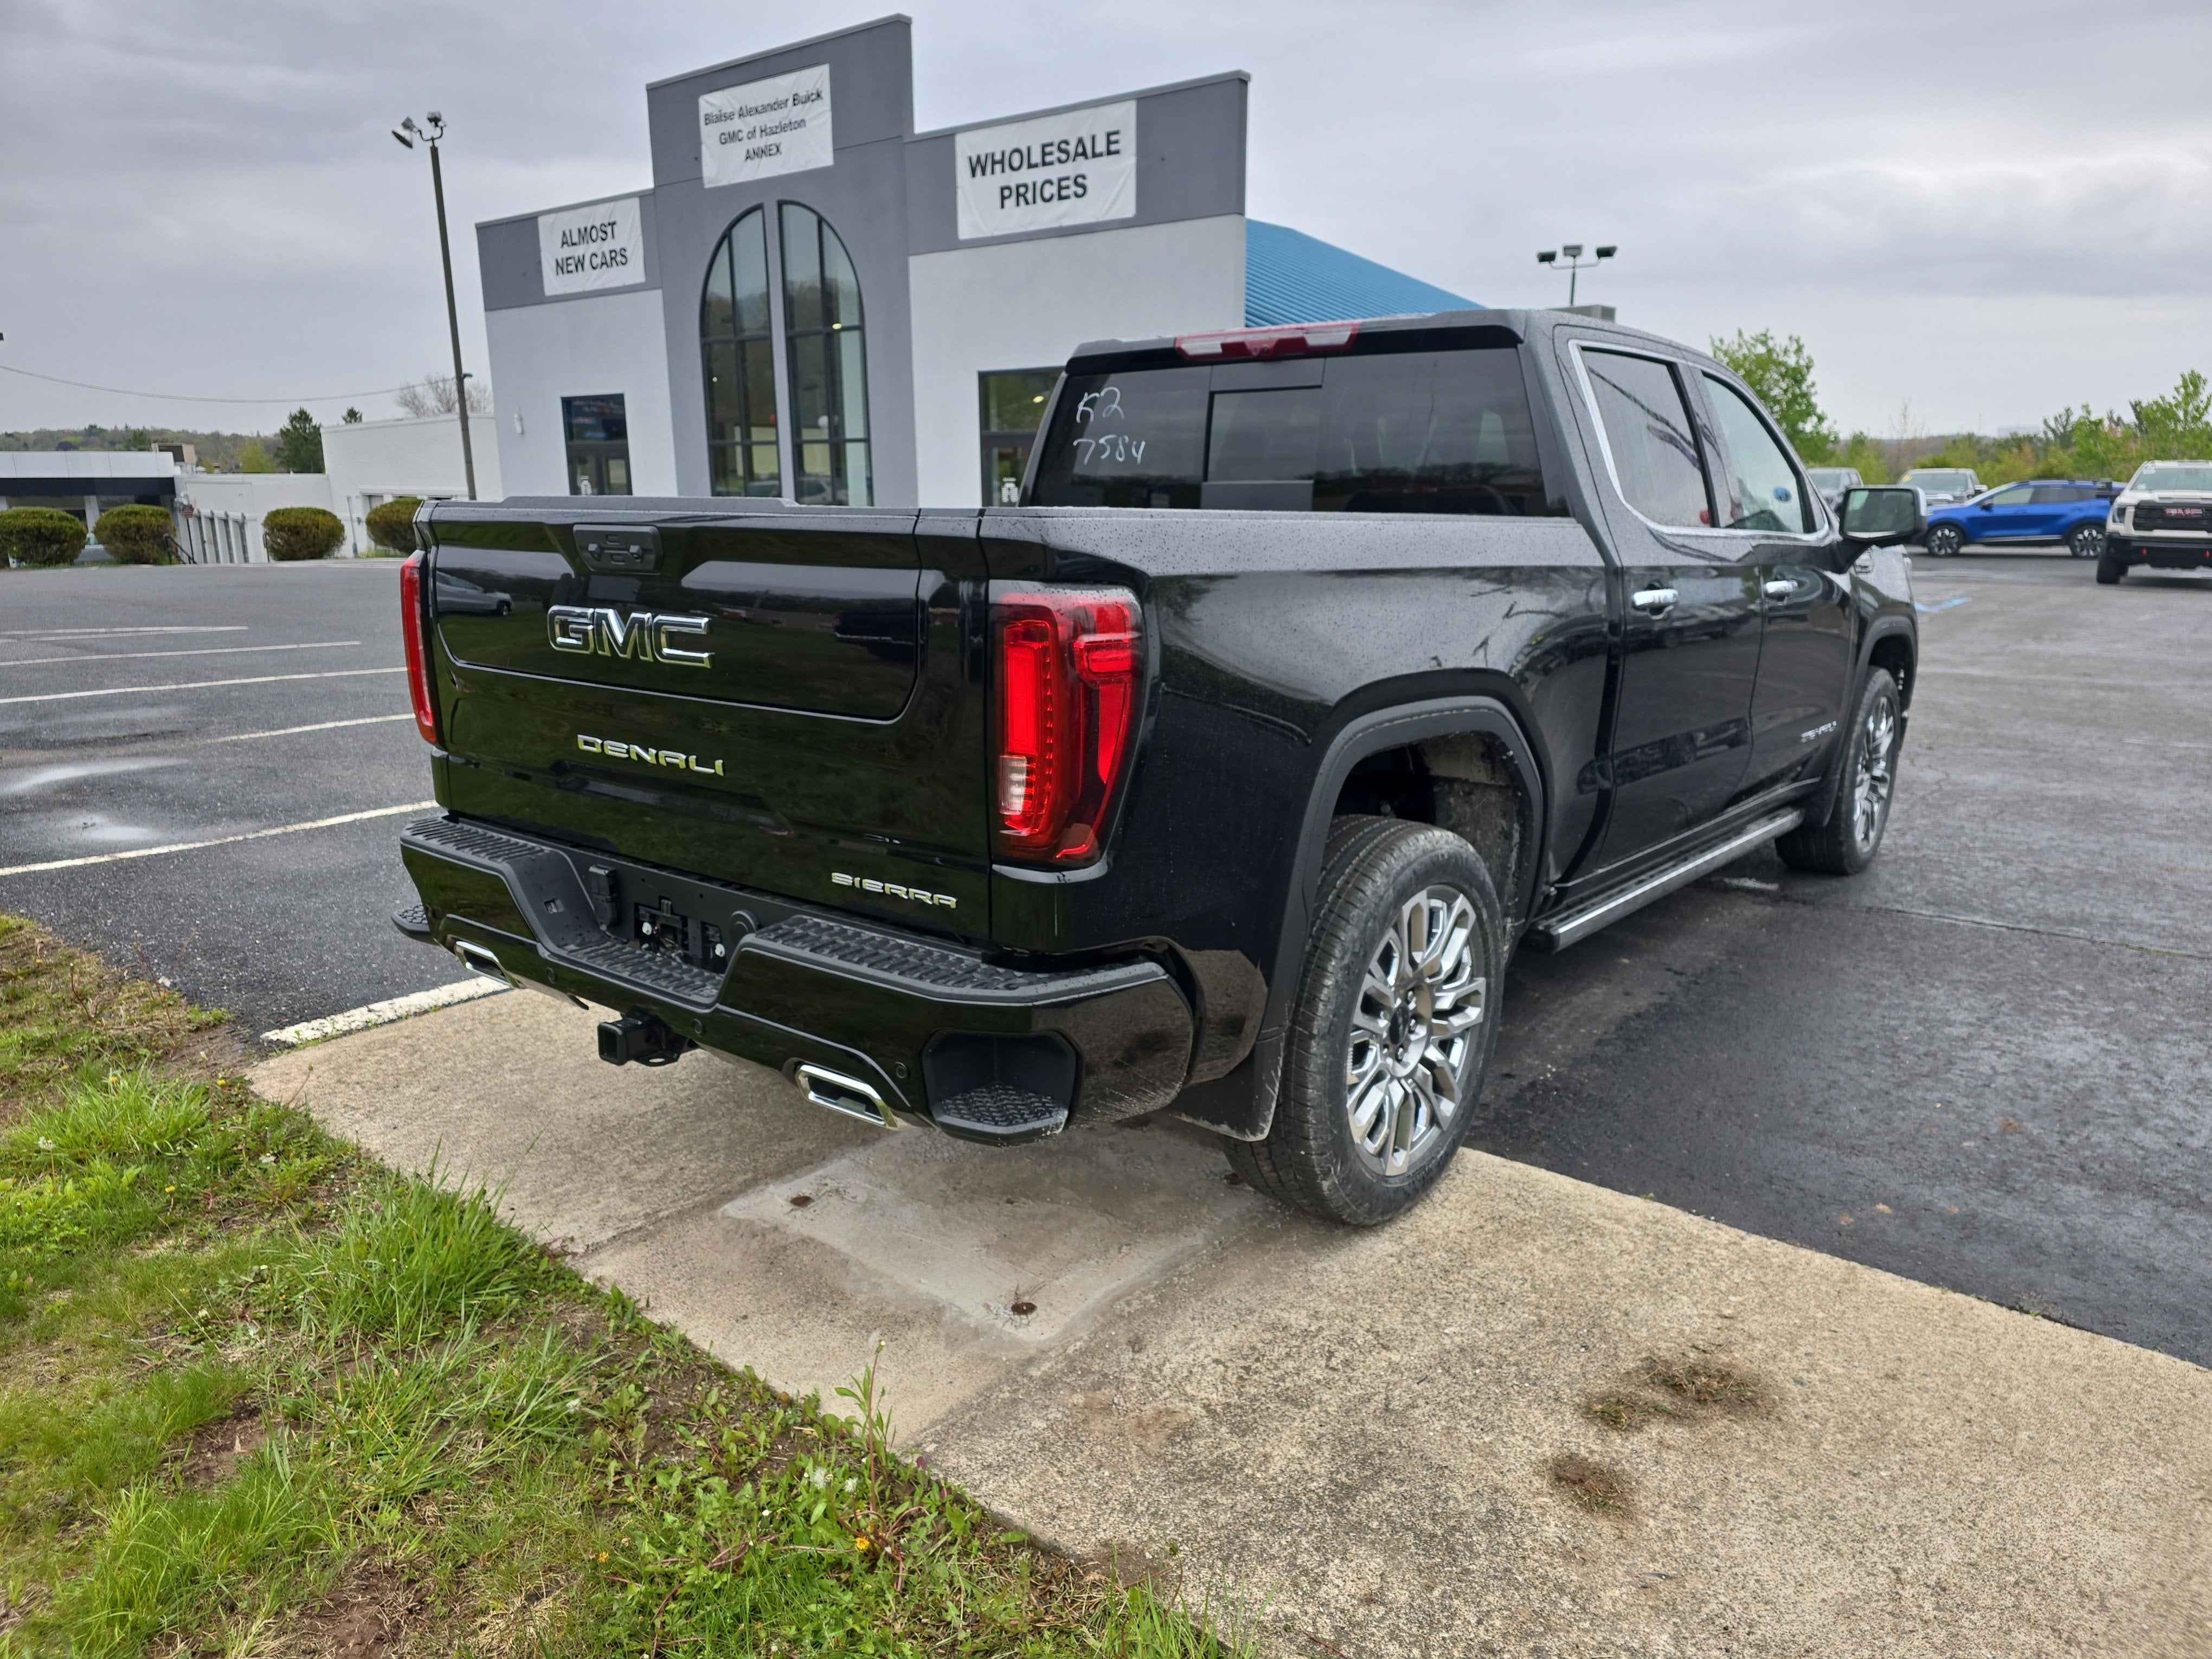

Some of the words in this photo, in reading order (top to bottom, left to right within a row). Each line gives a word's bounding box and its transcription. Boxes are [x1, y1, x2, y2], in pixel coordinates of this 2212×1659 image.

[704, 110, 735, 125] Blaise
[738, 97, 789, 119] Alexander
[793, 88, 823, 106] Buick
[719, 129, 743, 145] GMC
[747, 126, 756, 140] of
[760, 118, 806, 138] Hazleton
[745, 142, 782, 161] ANNEX
[967, 130, 1120, 178] WHOLESALE
[999, 173, 1088, 209] PRICES
[561, 220, 616, 248] ALMOST
[555, 254, 585, 275] NEW
[590, 247, 627, 270] CARS
[547, 605, 711, 668] GMC
[577, 734, 724, 776] DENALI
[832, 872, 958, 909] SIERRA
